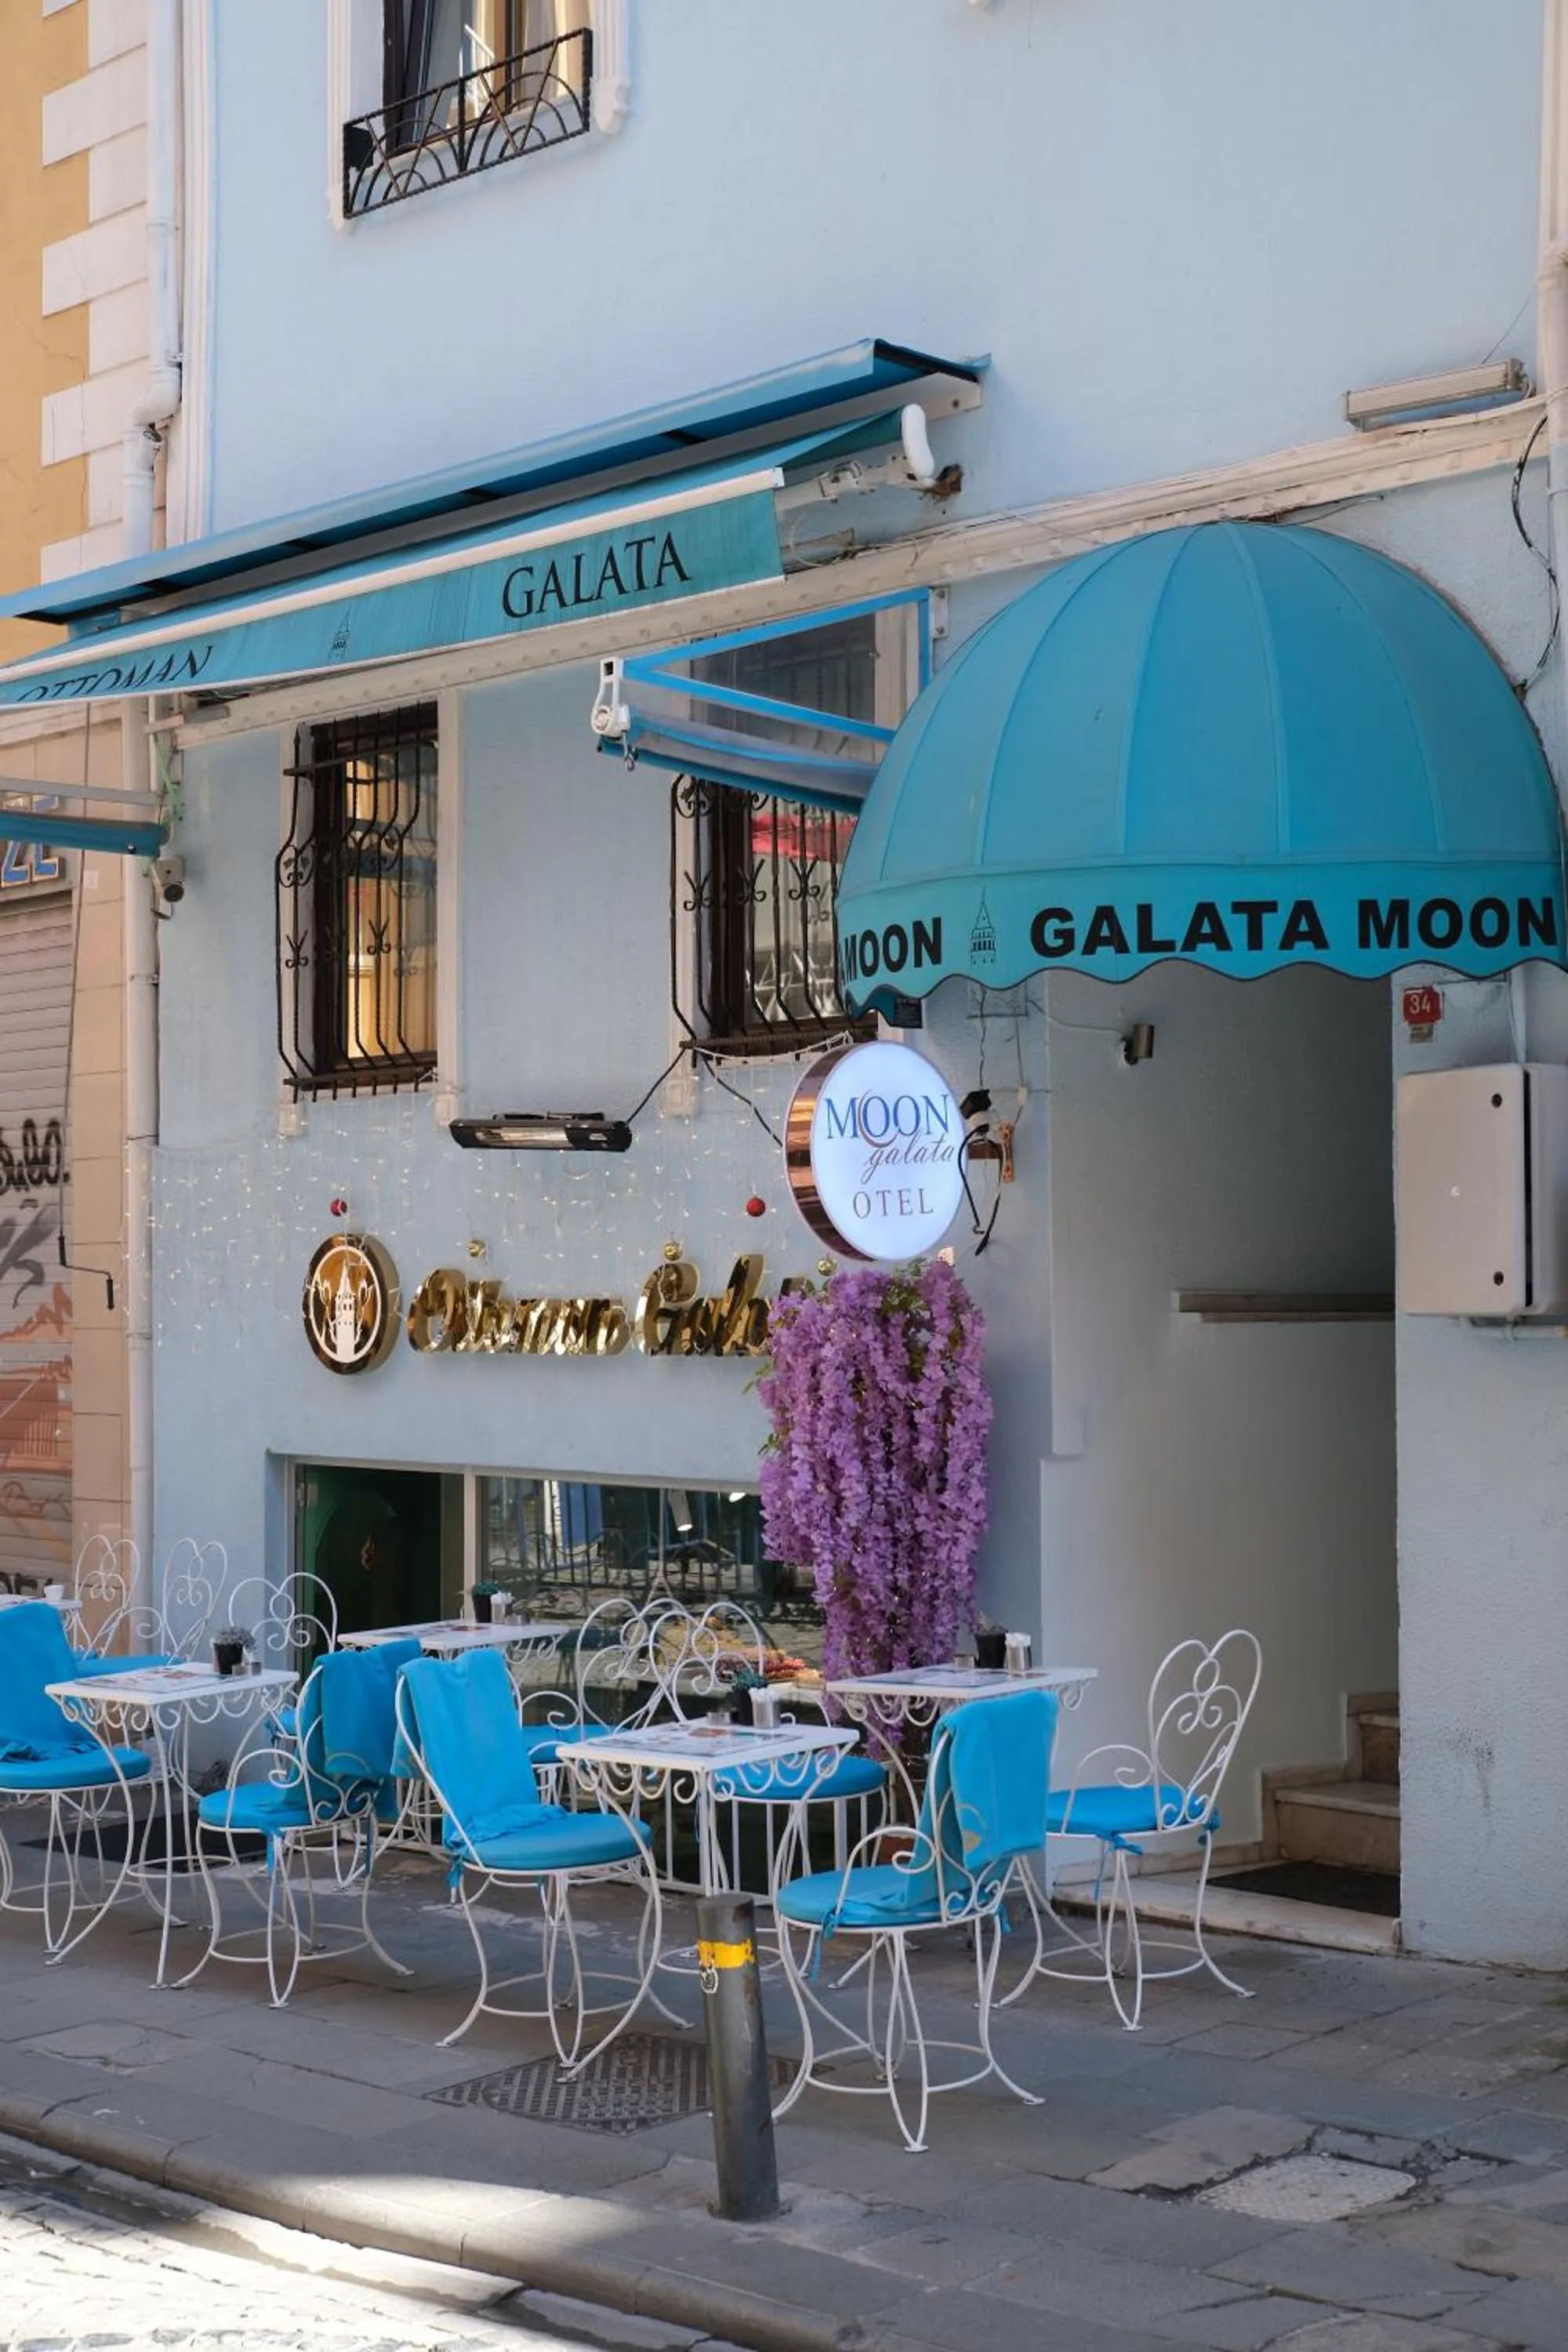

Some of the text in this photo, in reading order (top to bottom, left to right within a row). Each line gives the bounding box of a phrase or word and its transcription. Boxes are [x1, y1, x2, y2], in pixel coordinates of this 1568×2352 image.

[16, 530, 693, 702] OTTOMAN GALATA
[844, 916, 942, 982] MOON
[1030, 897, 1558, 958] GALATA MOON
[824, 1093, 949, 1141] MOON
[861, 1128, 955, 1185] galata
[852, 1187, 934, 1219] OTEL
